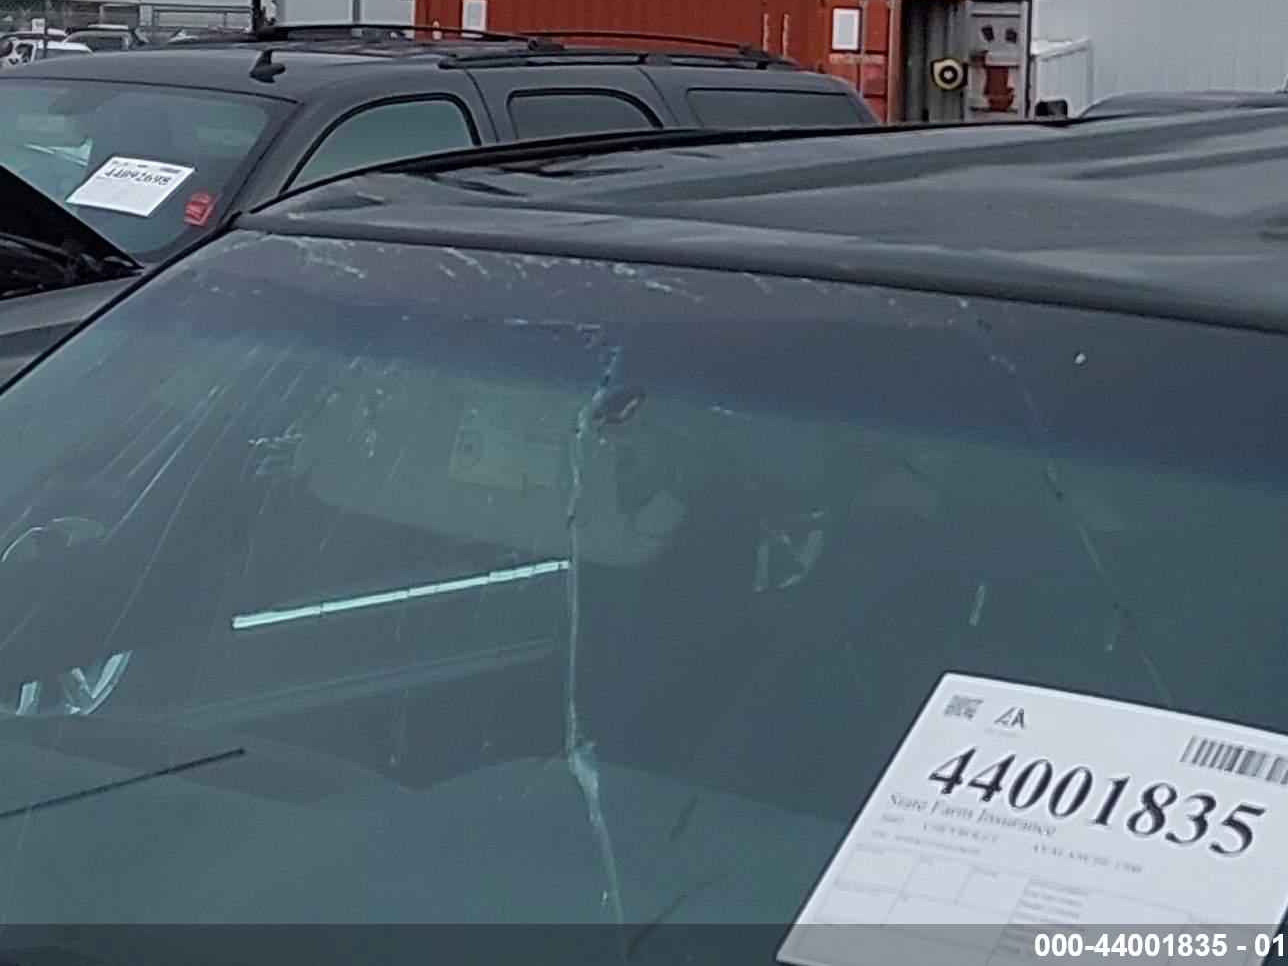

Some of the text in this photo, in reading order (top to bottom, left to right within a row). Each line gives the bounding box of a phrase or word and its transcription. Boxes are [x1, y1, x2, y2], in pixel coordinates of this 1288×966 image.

[888, 793, 928, 813] State
[930, 799, 974, 821] Farm
[978, 807, 1057, 835] Insurance
[929, 745, 1267, 857] 44001835
